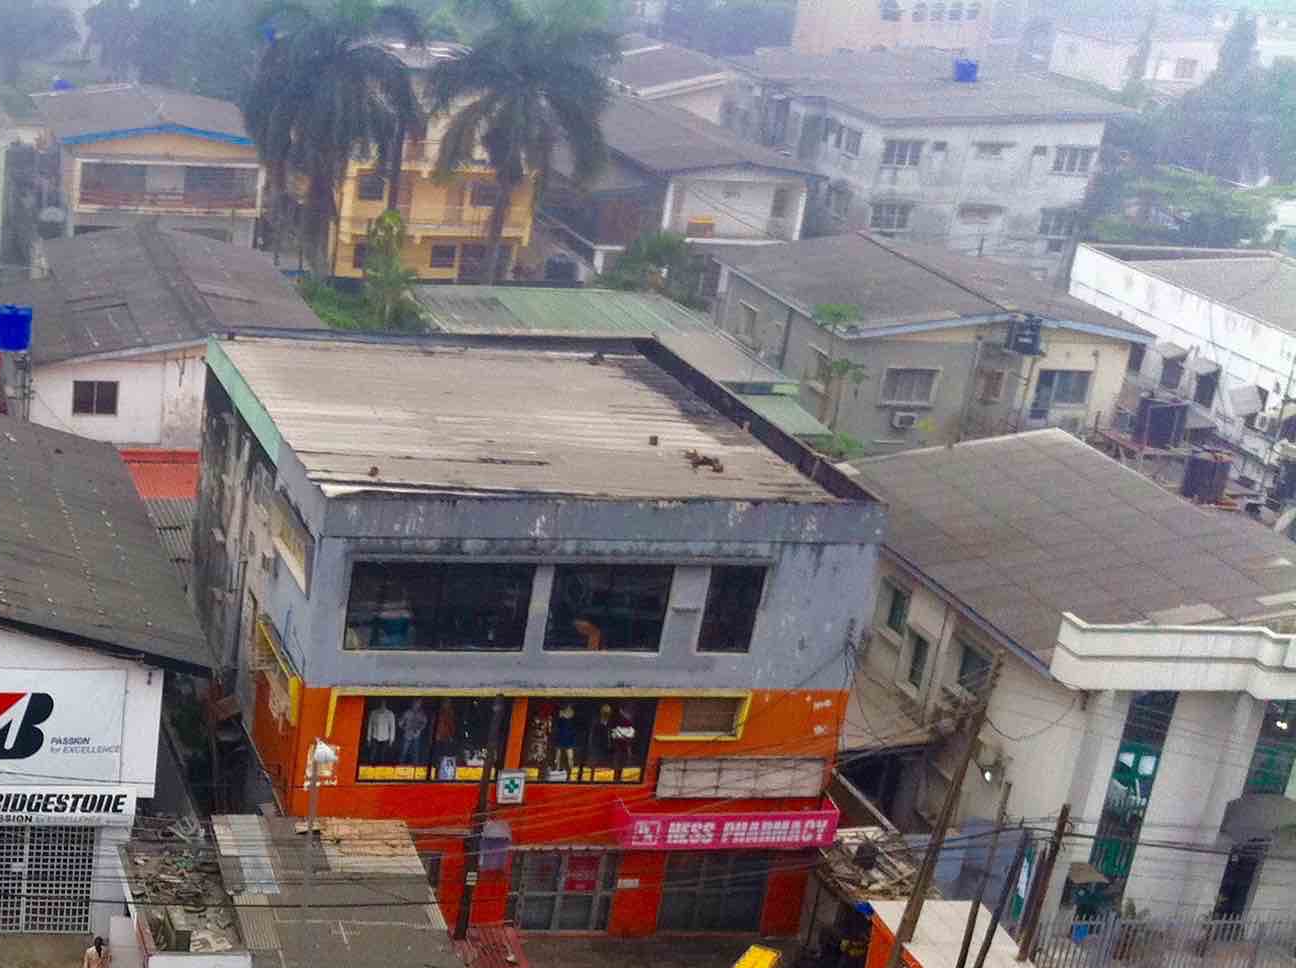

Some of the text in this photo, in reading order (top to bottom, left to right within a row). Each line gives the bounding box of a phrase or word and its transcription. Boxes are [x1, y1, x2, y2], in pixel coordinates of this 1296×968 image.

[50, 736, 91, 745] PASSION
[63, 745, 121, 753] EXCELLENCE
[720, 819, 829, 844] PHARMACY
